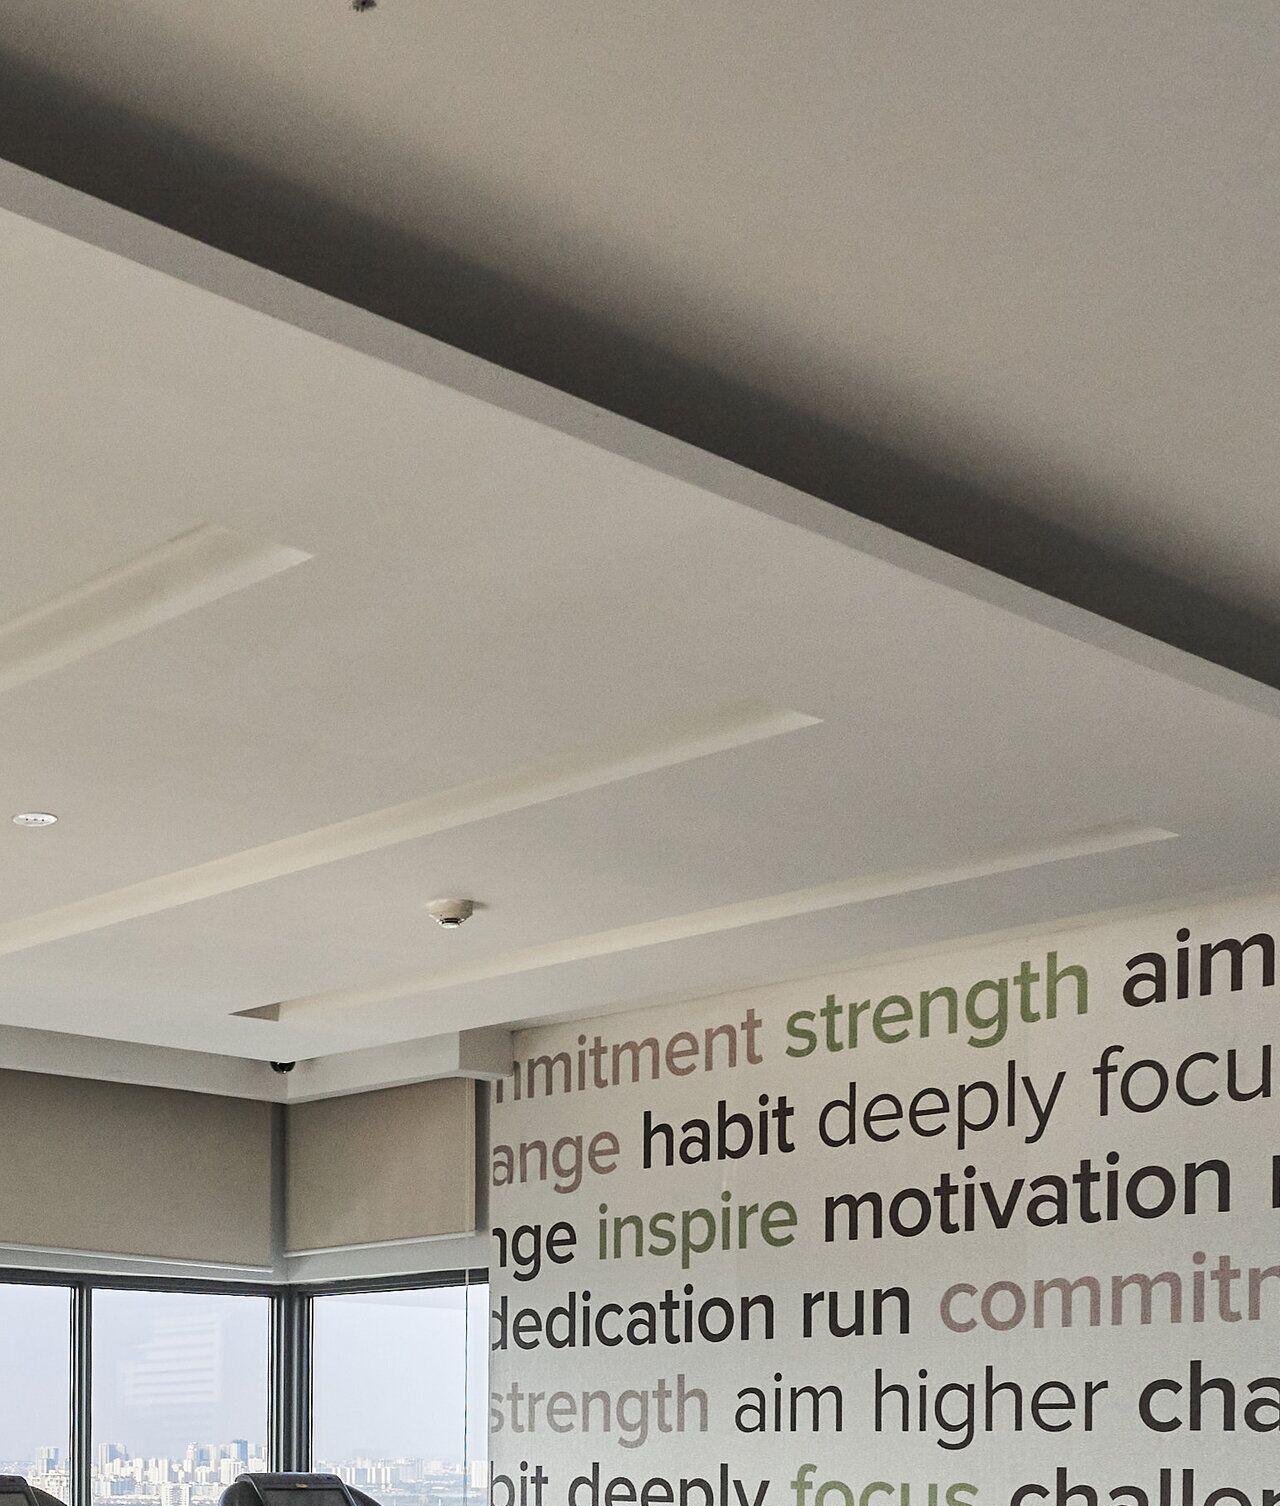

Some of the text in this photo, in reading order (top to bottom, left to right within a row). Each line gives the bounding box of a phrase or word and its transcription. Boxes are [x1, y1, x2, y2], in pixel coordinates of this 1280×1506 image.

[786, 951, 1088, 1058] strength
[1123, 928, 1275, 1007] aim
[493, 1131, 620, 1194] ange
[643, 1094, 795, 1169] habit
[819, 1060, 1066, 1150] deeply
[599, 1191, 797, 1269] inspire
[825, 1151, 1230, 1242] motivation
[803, 1287, 909, 1338] run
[735, 1372, 842, 1433] aim
[875, 1365, 1108, 1450] higher
